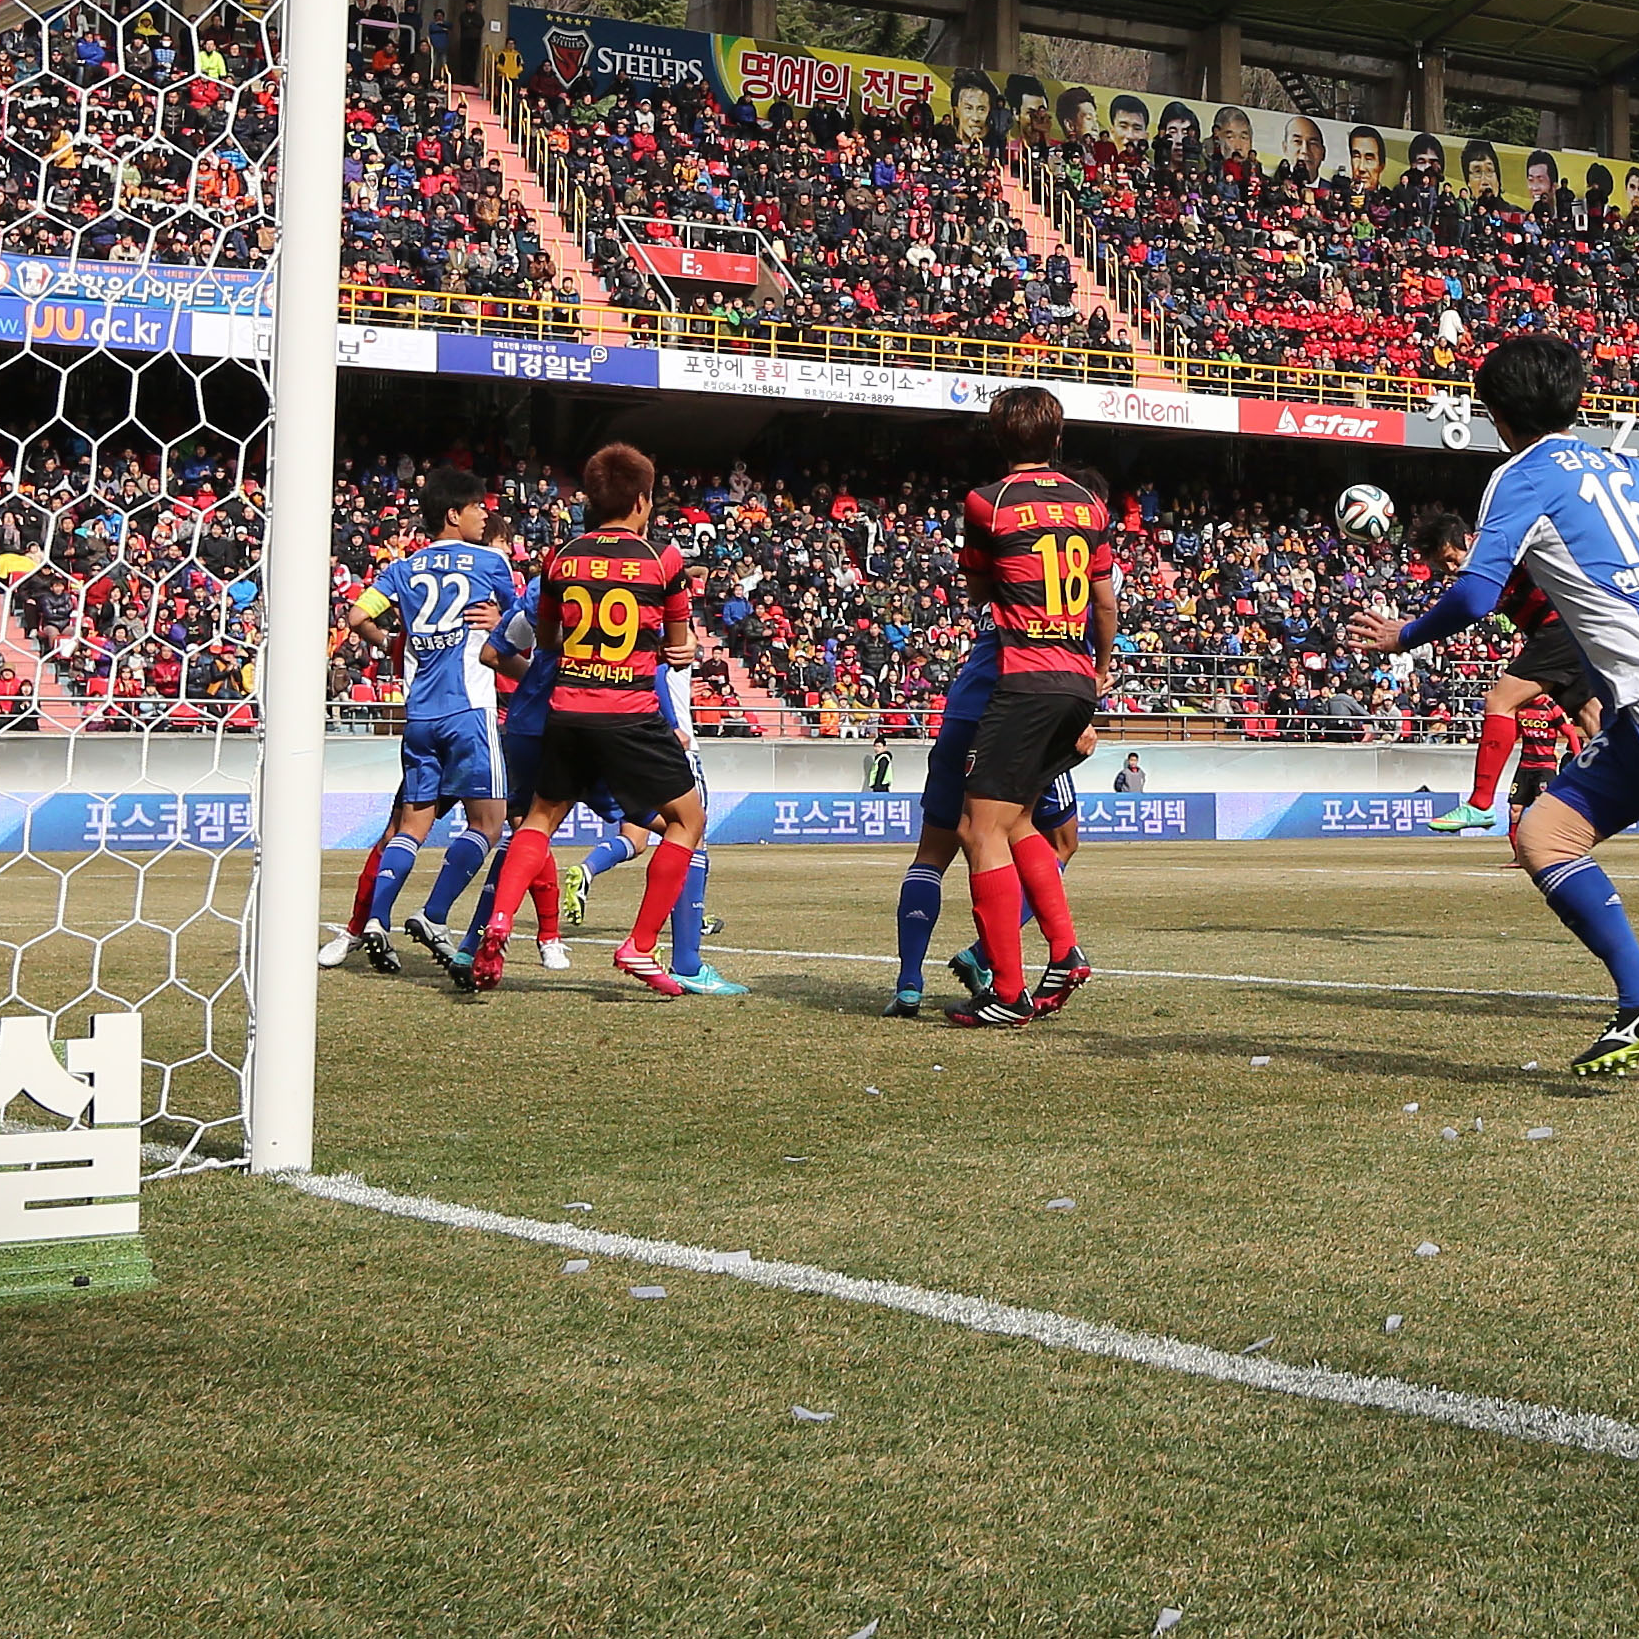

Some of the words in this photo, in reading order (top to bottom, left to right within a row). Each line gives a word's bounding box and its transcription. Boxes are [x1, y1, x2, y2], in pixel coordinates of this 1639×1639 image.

[597, 46, 705, 86] STEELERS
[628, 42, 672, 57] POHANG
[739, 49, 852, 108] 명예의
[861, 67, 934, 119] 전당
[491, 350, 593, 382] 대경일보
[683, 355, 743, 378] 포항에
[751, 359, 789, 383] 물회
[797, 364, 852, 387] 드시러
[1032, 534, 1090, 616] 18
[409, 572, 470, 633] 22
[562, 585, 640, 661] 29
[84, 800, 256, 843] 포스코켐텍
[773, 799, 912, 836] 포스코켐텍
[1321, 798, 1434, 832] 포스코켐텍
